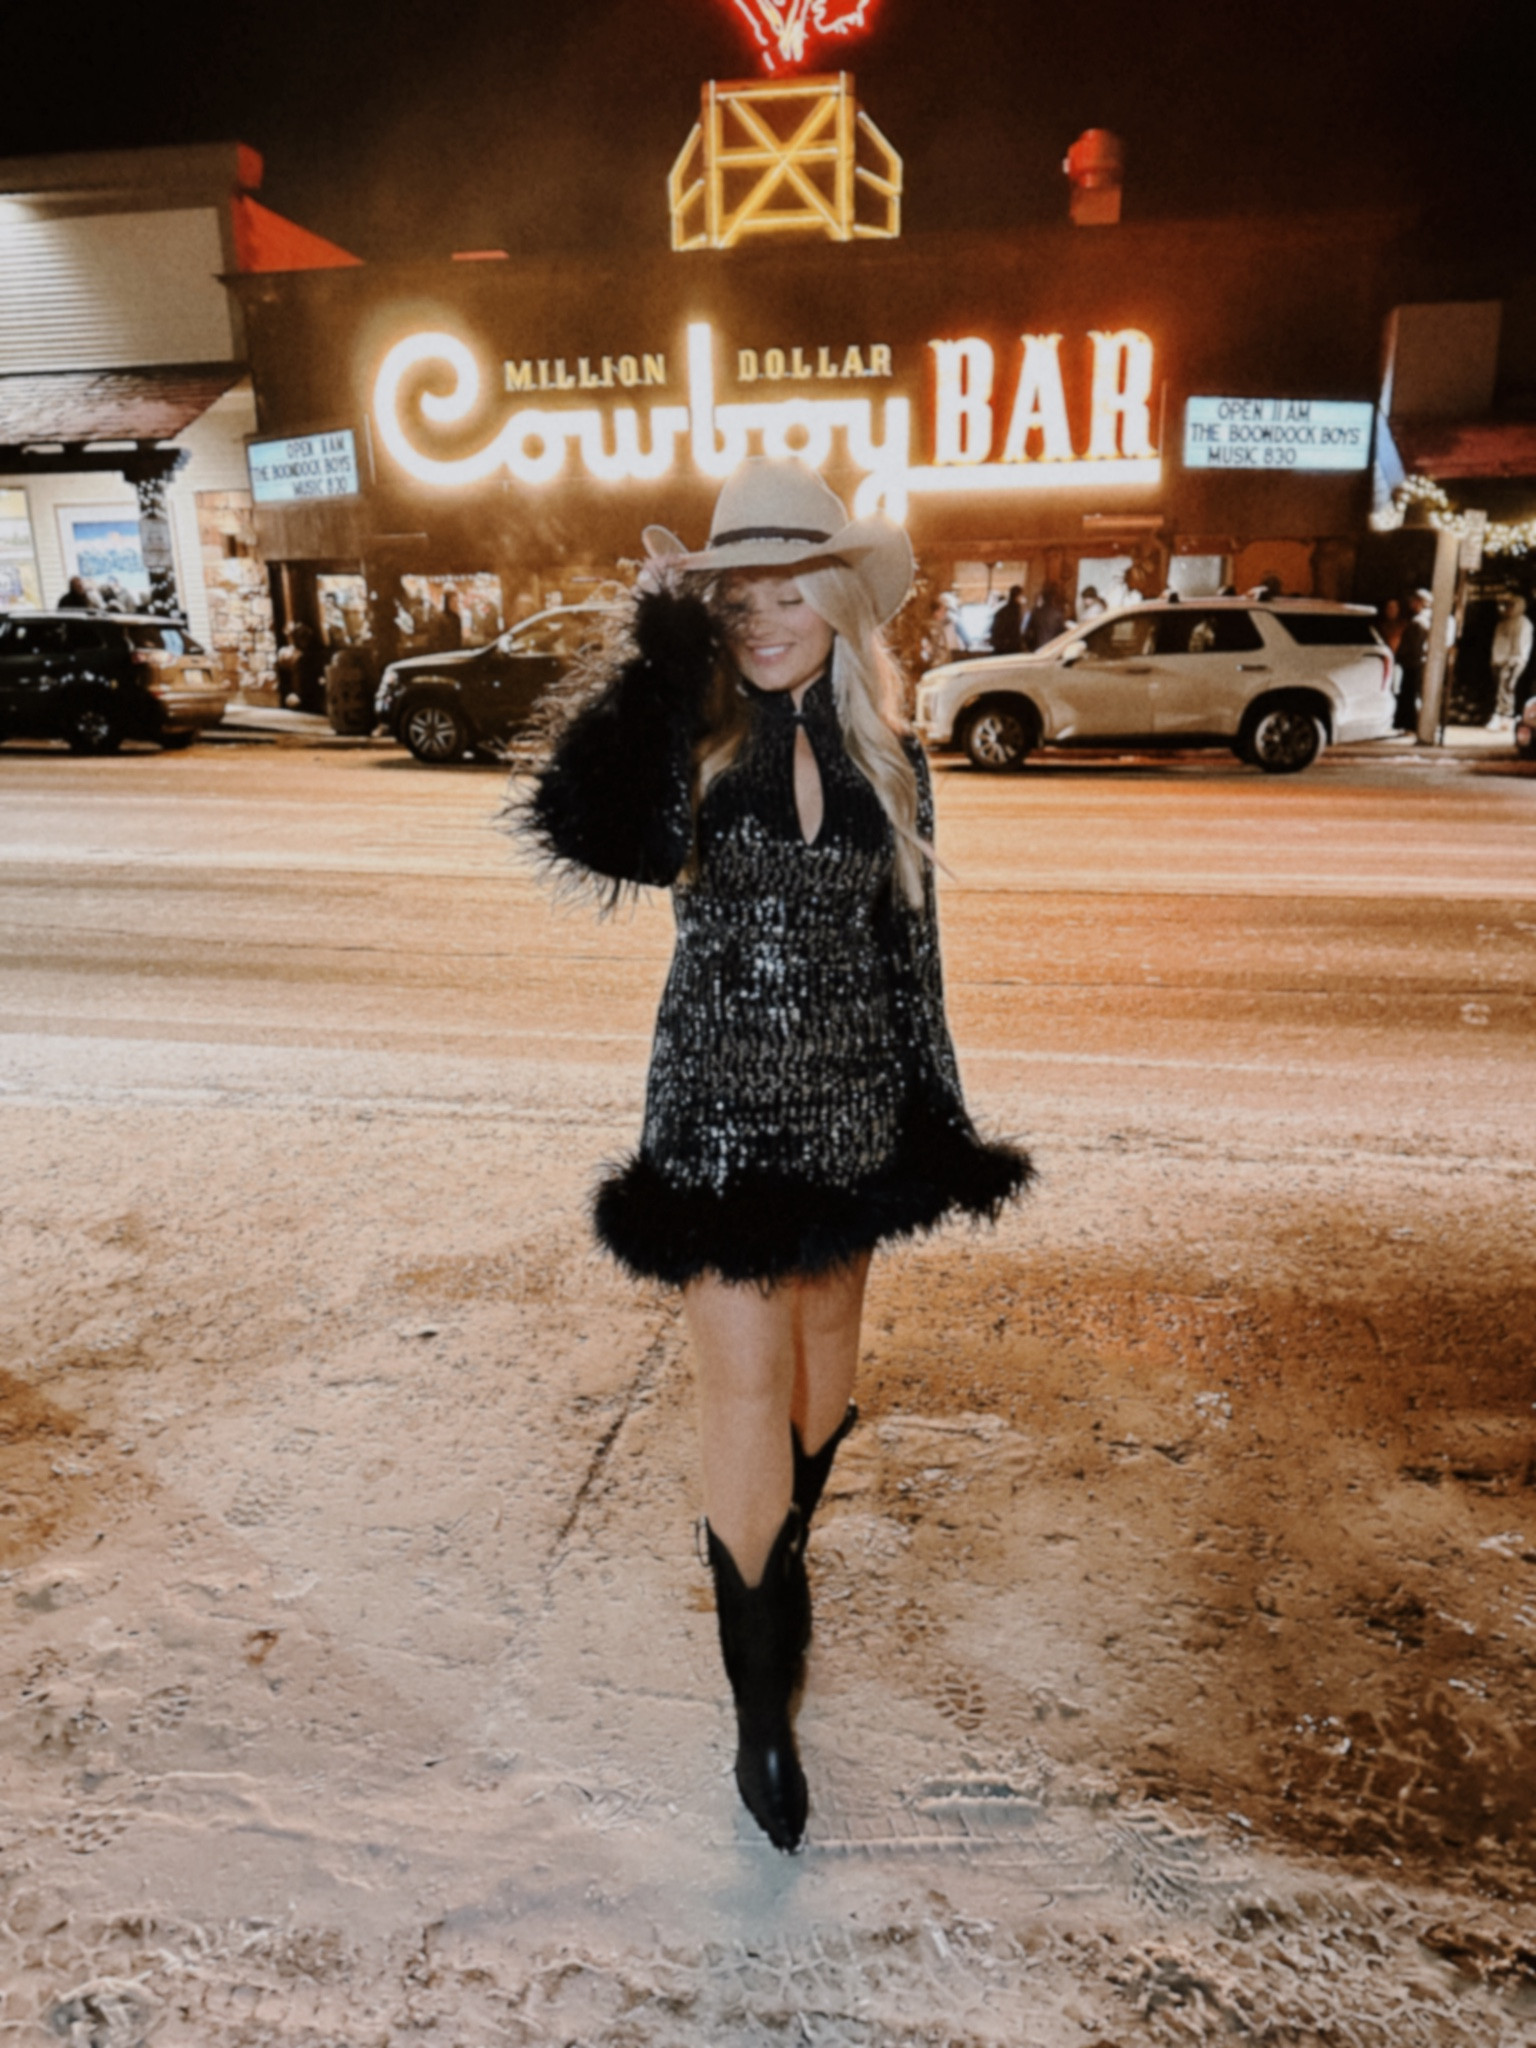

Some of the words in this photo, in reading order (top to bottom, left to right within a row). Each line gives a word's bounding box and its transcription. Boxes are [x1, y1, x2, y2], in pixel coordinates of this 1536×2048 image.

[504, 353, 668, 391] MILLION
[737, 343, 893, 382] DOLLAR
[1218, 401, 1264, 421] OPEN
[374, 322, 910, 525] Cowboy
[928, 329, 1161, 466] BAR
[1191, 423, 1221, 443] THE
[1229, 424, 1316, 445] BOONDOCK
[1321, 427, 1361, 446] BOYS
[1208, 447, 1259, 465] MUSIC
